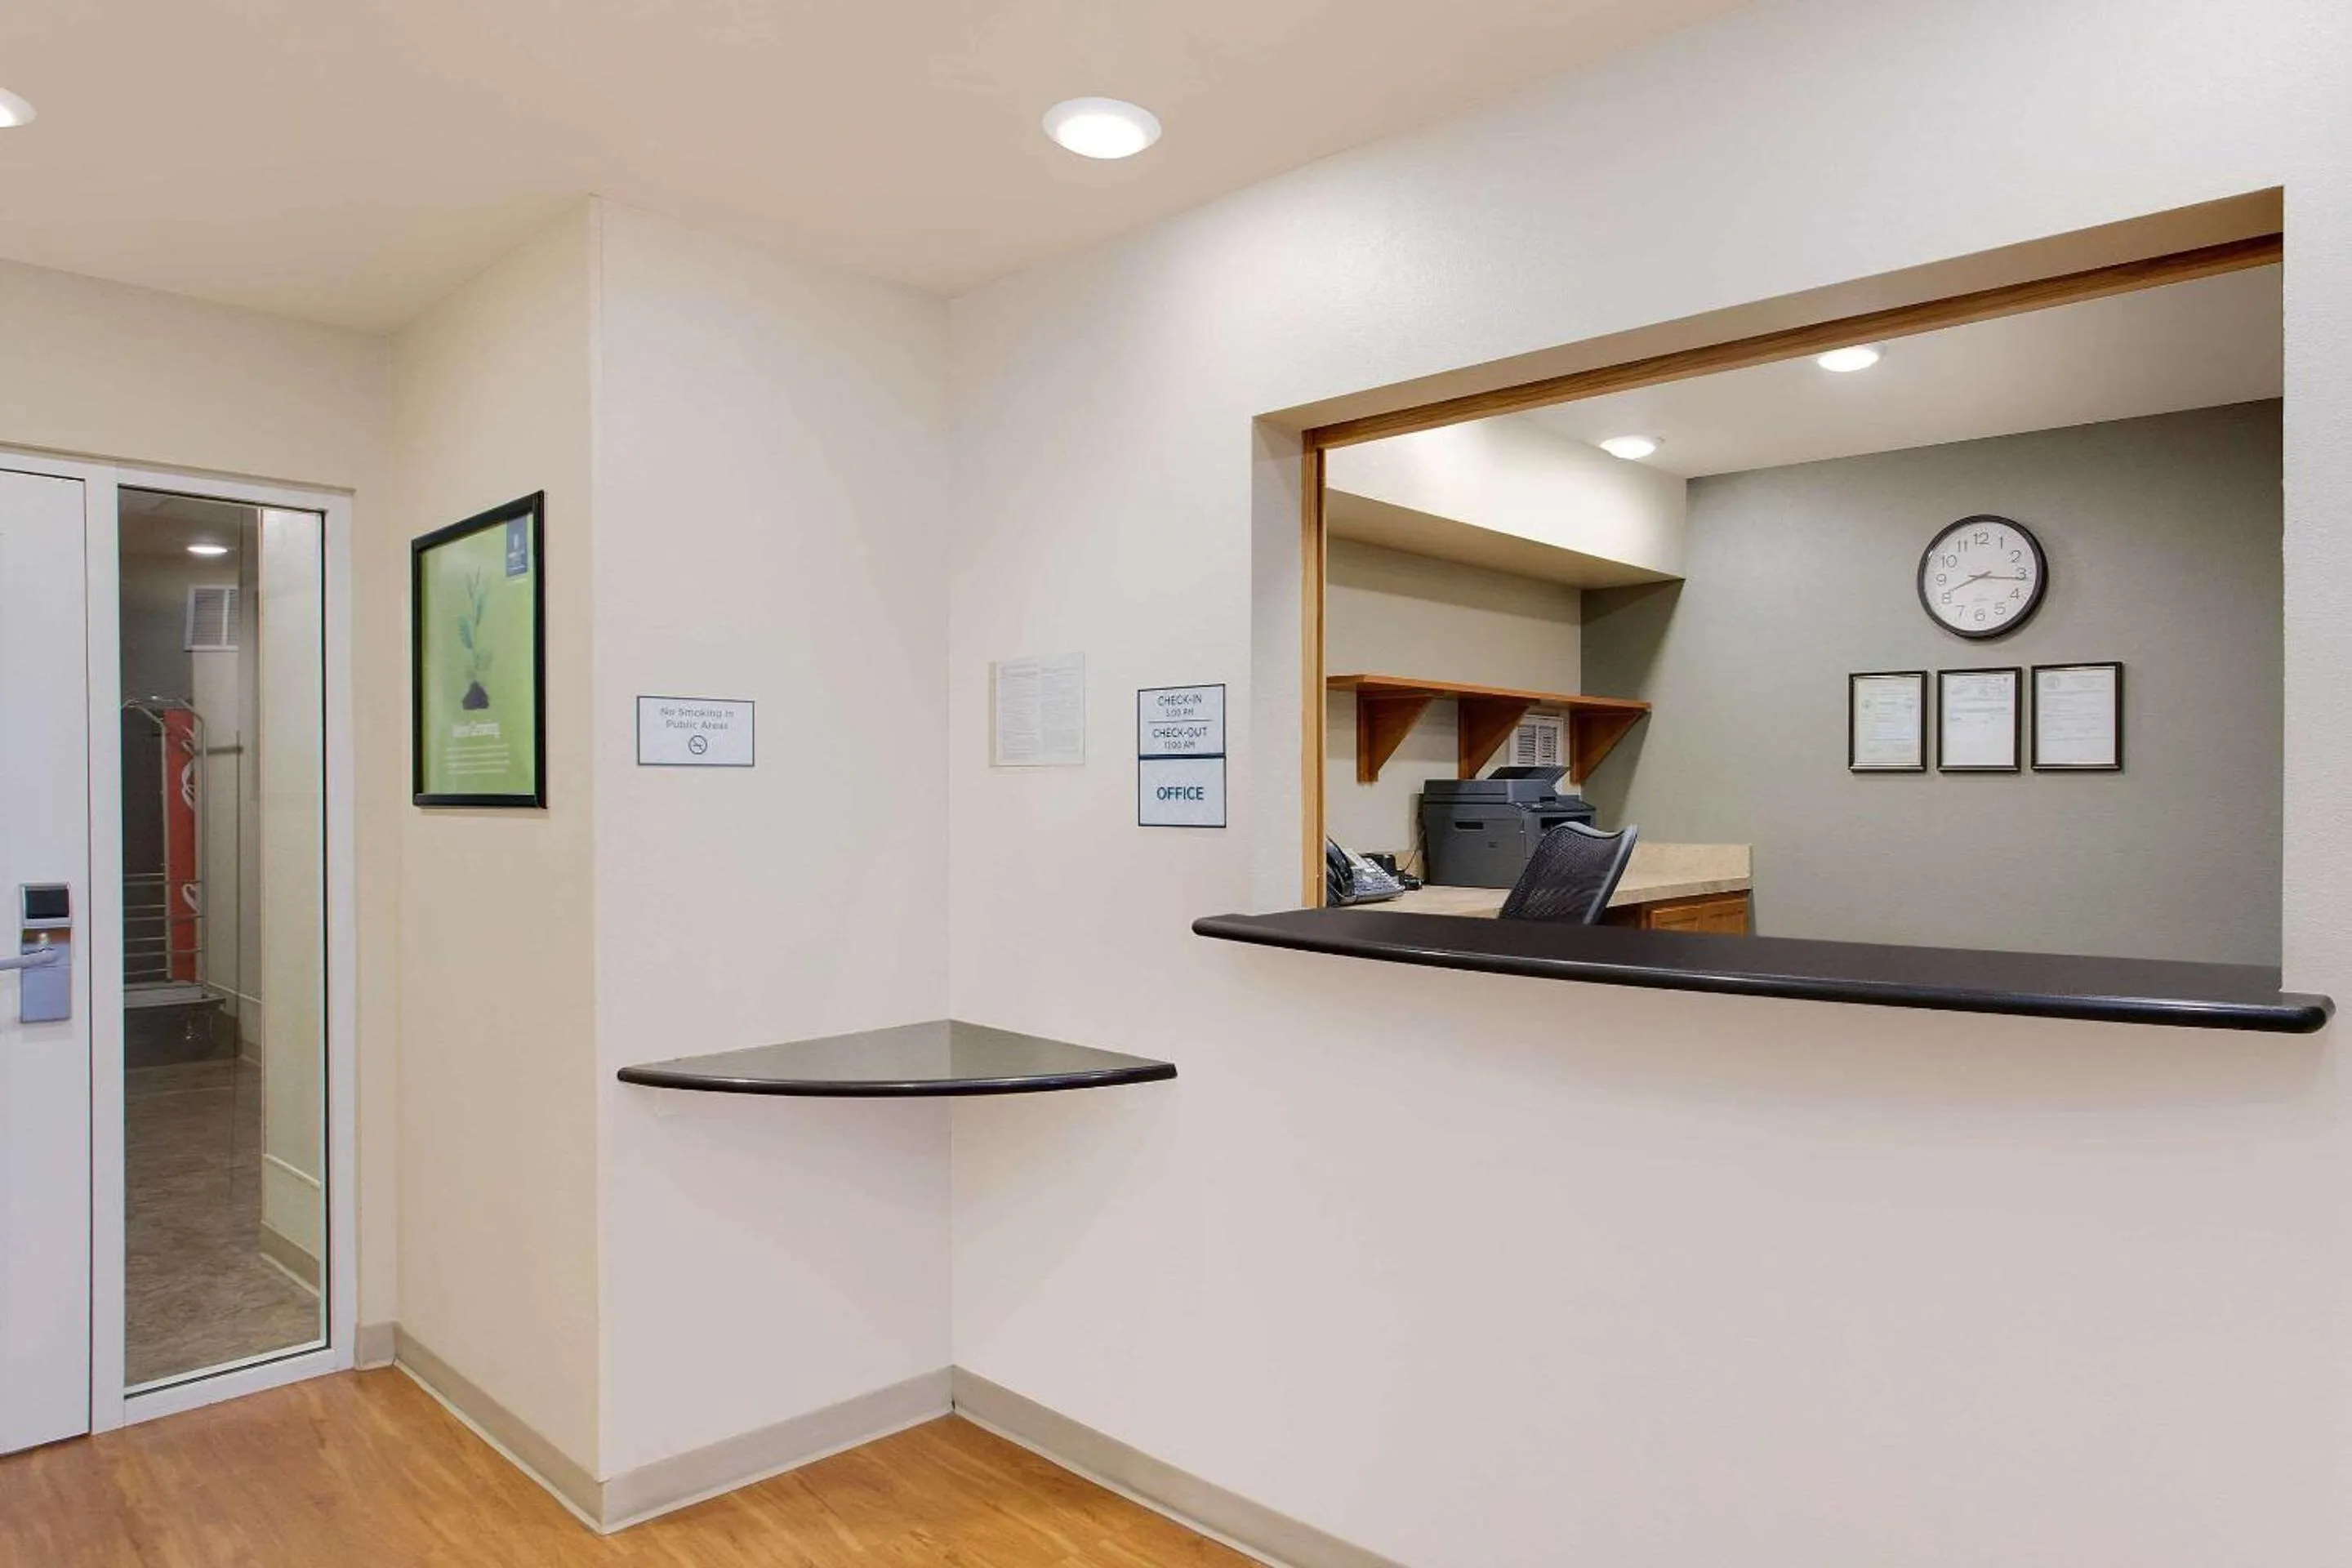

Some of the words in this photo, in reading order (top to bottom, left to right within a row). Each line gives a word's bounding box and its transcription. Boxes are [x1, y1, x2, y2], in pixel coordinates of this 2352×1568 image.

[1974, 532, 1989, 545] 12
[1958, 540, 1967, 552] 11
[1942, 555, 1958, 568] 10
[2011, 550, 2021, 563] 2
[1936, 573, 1947, 586] 9
[2018, 568, 2027, 581] 3
[1942, 591, 1952, 604] 8
[2010, 588, 2020, 599] 4
[1957, 605, 1966, 617] 7
[1975, 608, 1985, 621] 6
[1994, 602, 2006, 615] 5
[1157, 693, 1202, 706] CHECK-IN
[660, 706, 675, 716] No
[679, 708, 722, 719] Smoking
[1152, 727, 1208, 738] CHECK-OUT
[1156, 786, 1205, 801] OFFICE
